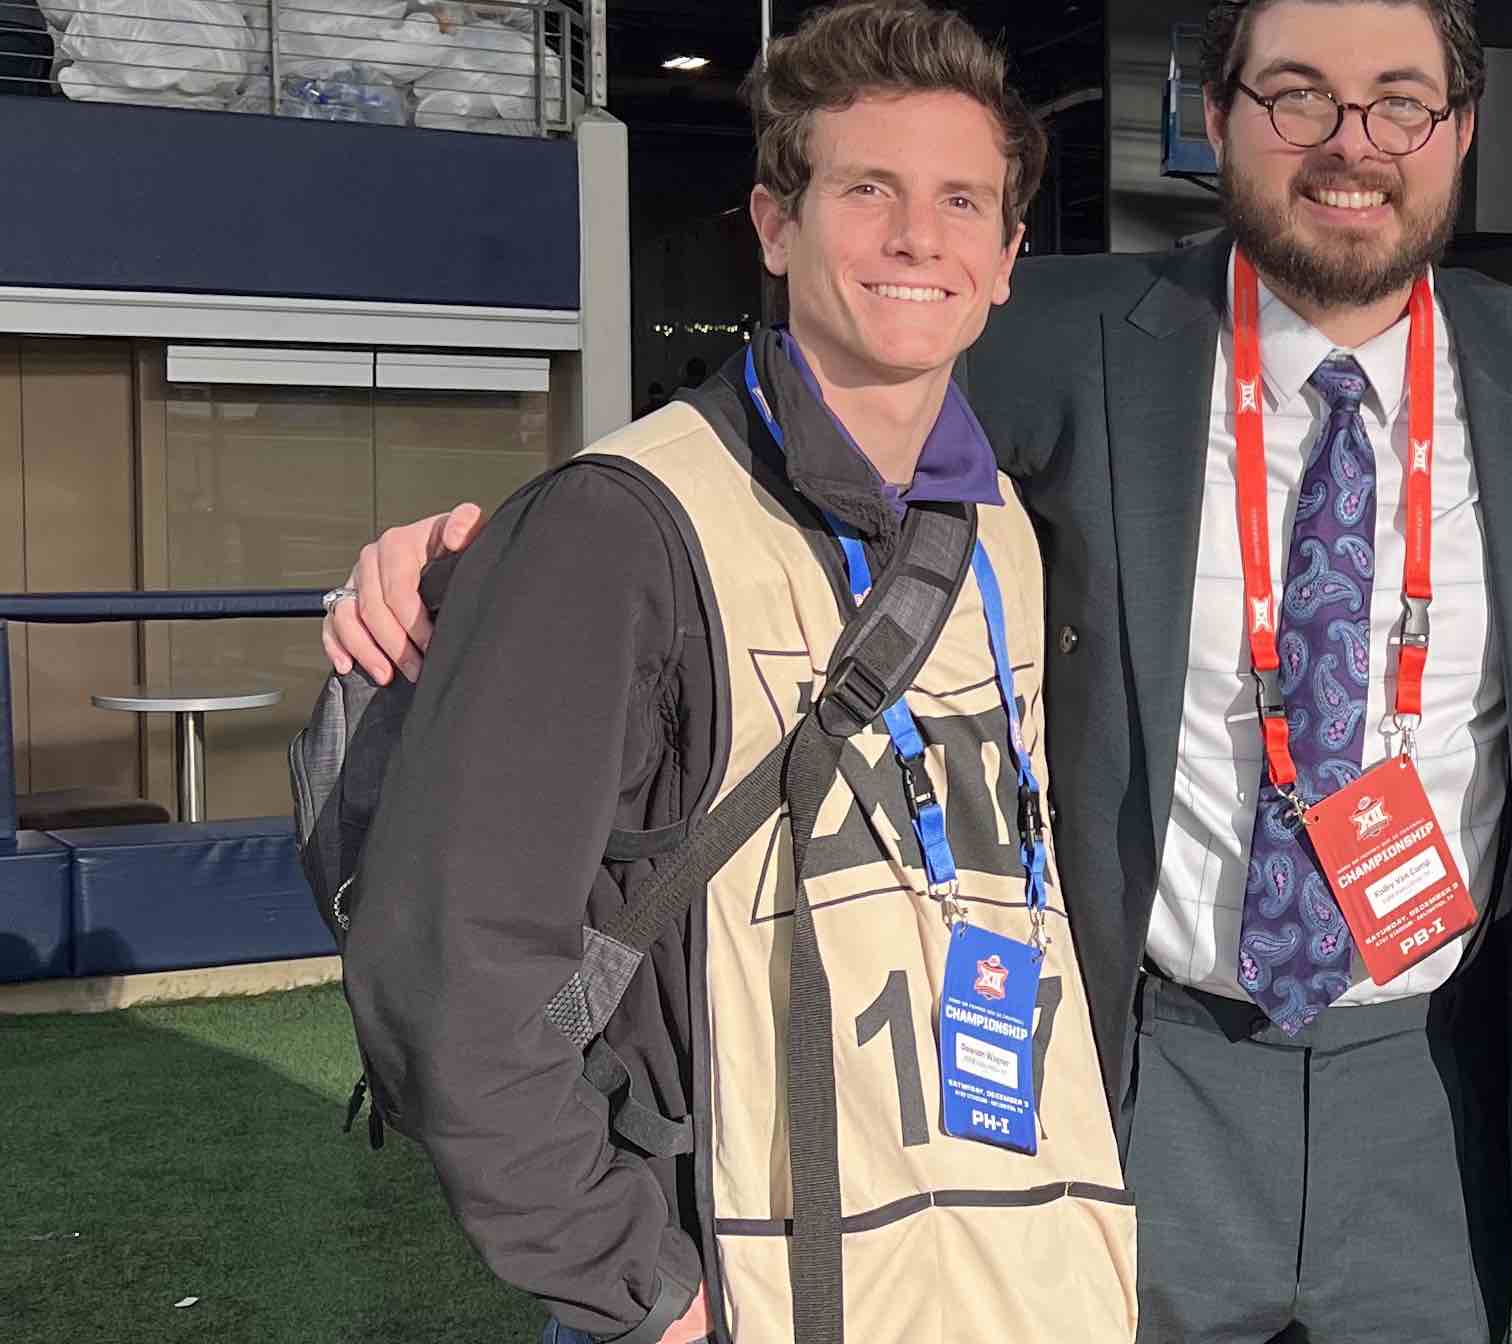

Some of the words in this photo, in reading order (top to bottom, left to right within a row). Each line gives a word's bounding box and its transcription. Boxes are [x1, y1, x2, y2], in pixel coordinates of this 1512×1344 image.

[1337, 820, 1434, 889] CHAMPIONSHIP
[1399, 917, 1446, 956] PB-I
[945, 1003, 1029, 1041] CHAMPIONSHIP
[972, 1109, 1010, 1135] PH-I
